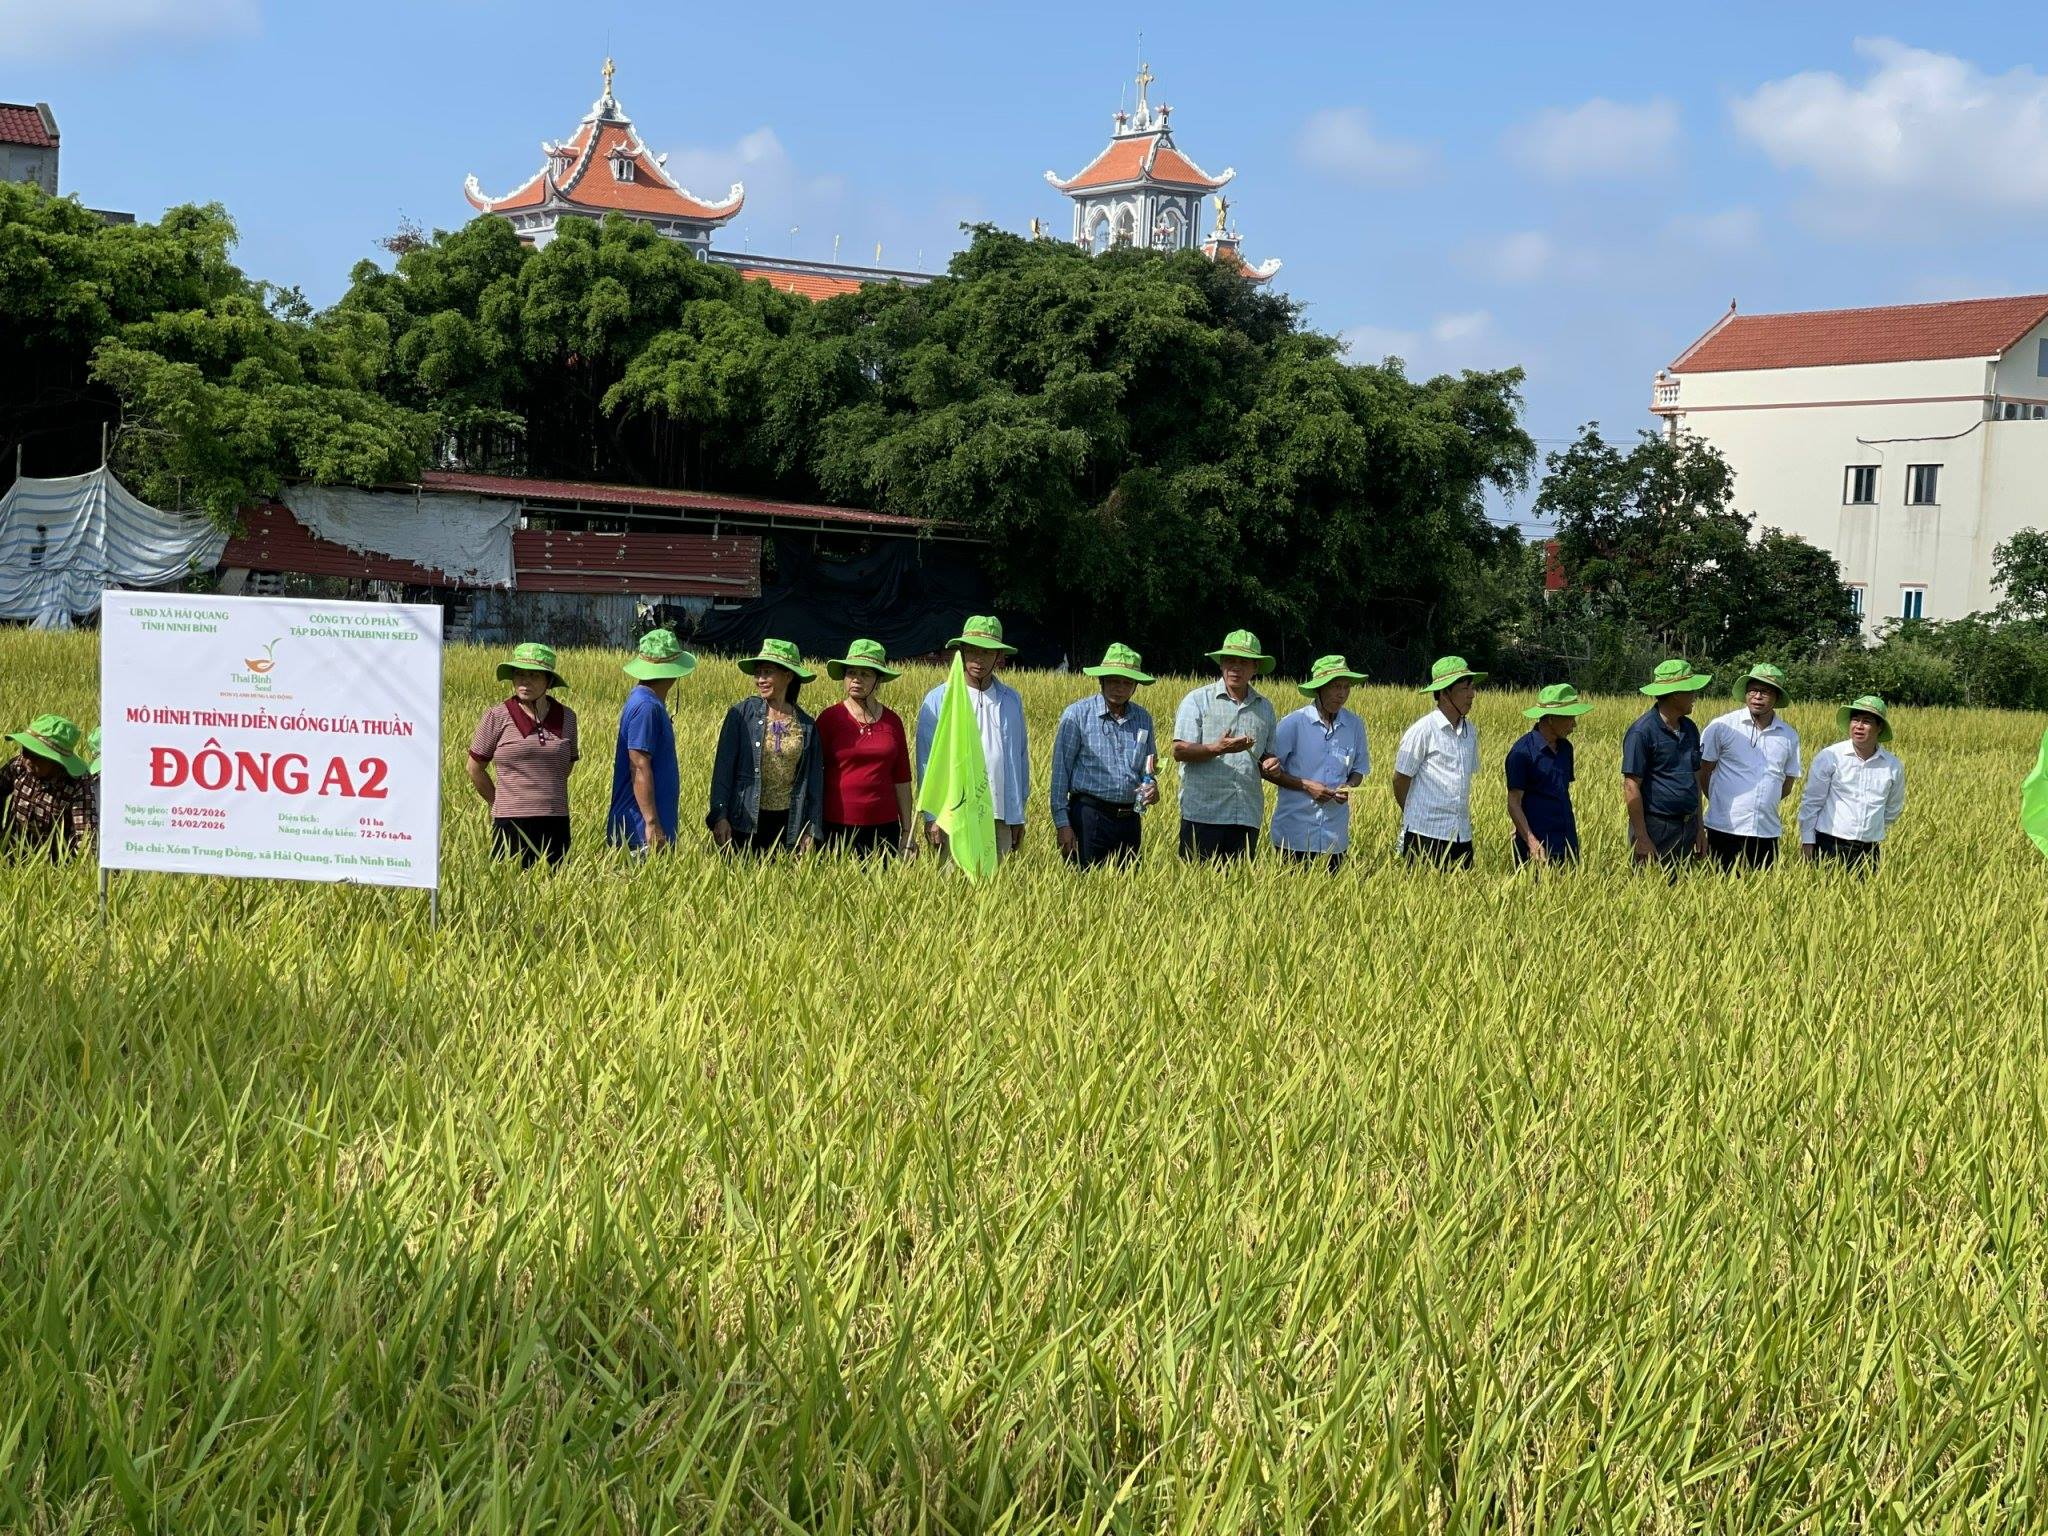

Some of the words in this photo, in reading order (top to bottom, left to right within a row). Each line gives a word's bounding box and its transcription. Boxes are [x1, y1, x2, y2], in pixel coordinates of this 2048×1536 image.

[130, 608, 158, 617] UBND
[194, 611, 229, 621] QUANG
[340, 616, 353, 625] TY
[167, 622, 191, 632] NINH
[392, 631, 419, 641] SEED
[255, 684, 272, 692] Seed
[126, 704, 150, 723] MÔ
[154, 706, 190, 725] HÌNH
[193, 708, 238, 728] TRÌNH
[242, 707, 278, 730] DIỄN
[280, 708, 329, 732] GIỐNG
[332, 715, 359, 734] LÚA
[362, 713, 413, 736] THUẦN
[150, 737, 309, 795] ĐÔNG
[318, 756, 389, 799] A2
[172, 807, 226, 818] 05/02/2026
[171, 820, 225, 830] 24/02/2026
[360, 817, 370, 826] 01
[372, 818, 384, 827] ha
[360, 830, 387, 839] 72-76
[389, 831, 412, 842] tạ/ha
[126, 842, 143, 854] Địa
[166, 844, 190, 855] Xóm
[192, 846, 224, 858] Trung
[294, 852, 333, 865] Quang,
[360, 856, 384, 867] Ninh
